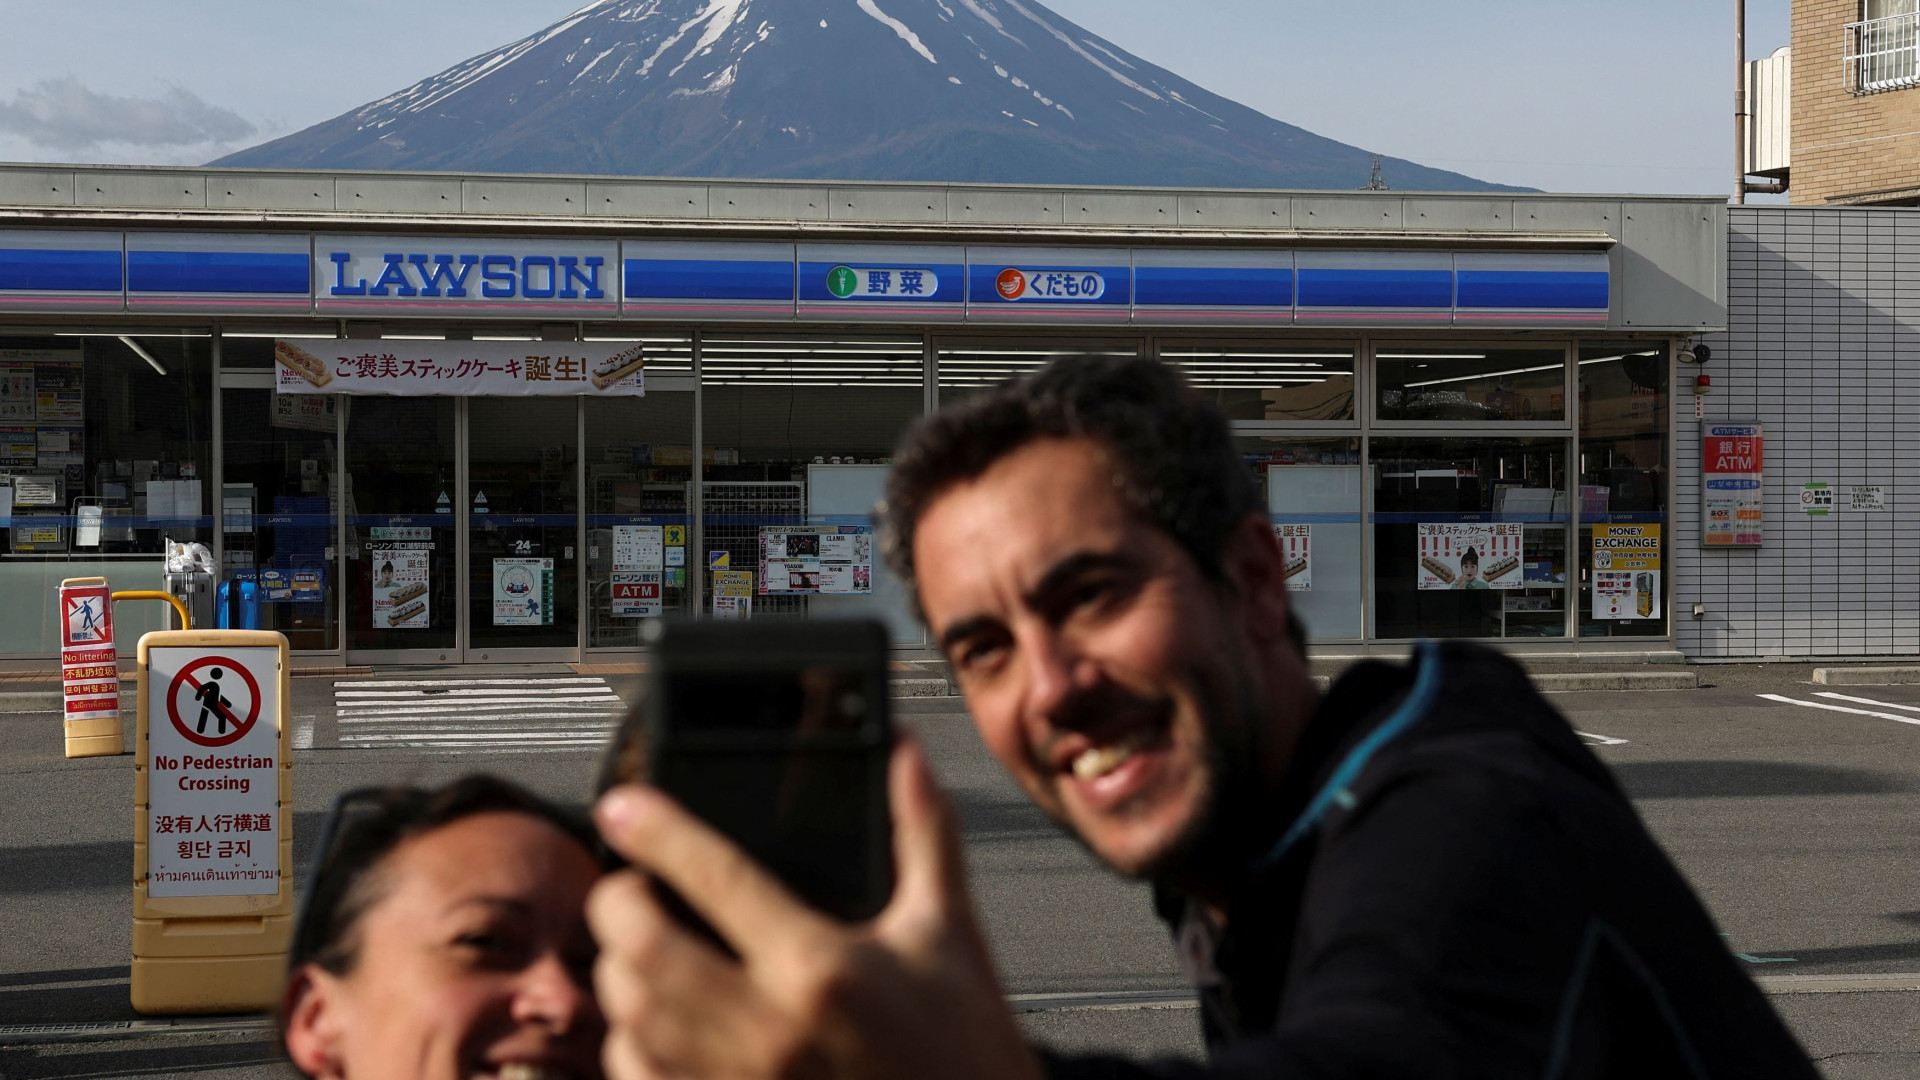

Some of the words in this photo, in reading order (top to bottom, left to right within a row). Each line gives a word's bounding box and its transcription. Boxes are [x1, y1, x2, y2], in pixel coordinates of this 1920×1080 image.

[330, 252, 604, 298] LAWSON
[868, 271, 922, 294] 野菜
[1030, 273, 1097, 296] くだもの
[1714, 427, 1756, 435] ATMサービス
[1719, 441, 1751, 454] 銀行
[1716, 456, 1752, 470] ATM
[1815, 497, 1832, 505] 禁煙
[1609, 528, 1643, 536] MONEY
[515, 539, 532, 550] 24
[1595, 539, 1658, 548] EXCHANGE
[613, 574, 659, 582] ローソン銀行
[620, 586, 652, 597] ATM
[64, 654, 77, 662] No
[79, 652, 114, 661] littering
[66, 667, 115, 679] 不乱扔垃圾
[155, 756, 178, 770] No
[183, 754, 273, 769] Pedestrian
[179, 775, 250, 793] Crossing
[155, 813, 272, 833] 没有人行横道
[177, 841, 212, 859] 횡단
[217, 840, 251, 858] 금지
[155, 863, 273, 882] ห้ามคนเดินเท้าข้าม
